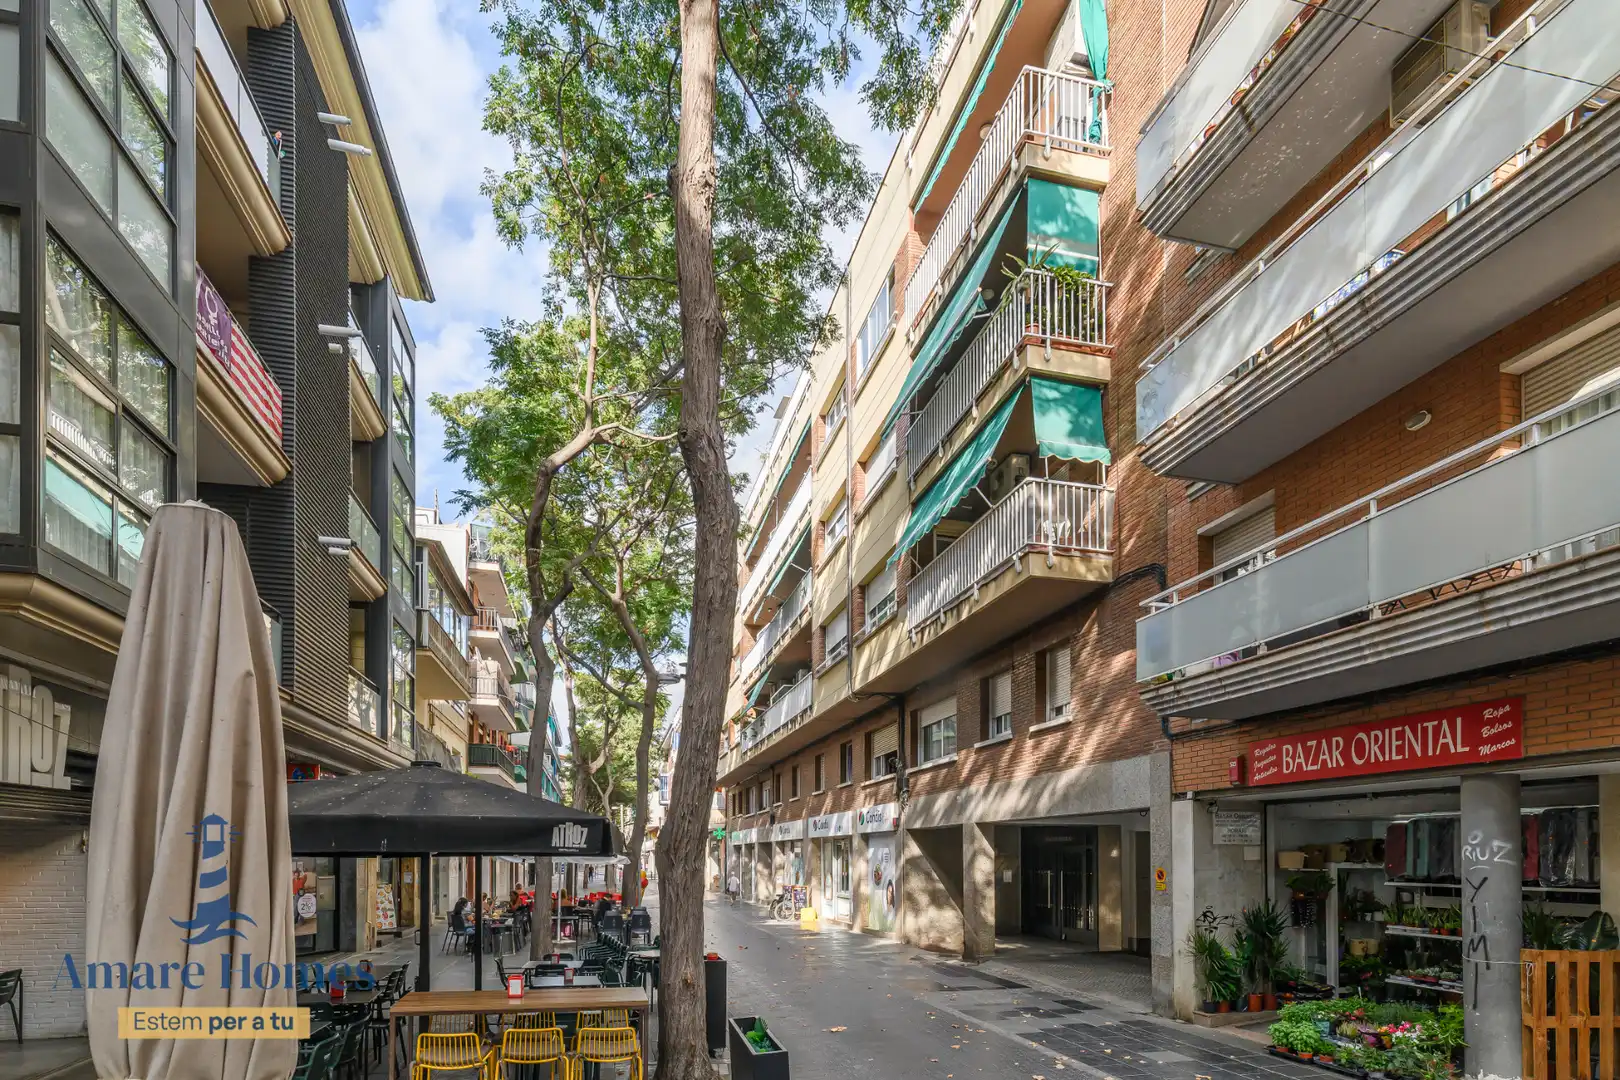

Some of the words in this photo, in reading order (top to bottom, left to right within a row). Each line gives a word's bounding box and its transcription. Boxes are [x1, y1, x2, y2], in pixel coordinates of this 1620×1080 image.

[1483, 704, 1511, 720] Ropa
[1481, 720, 1513, 738] Bolsos
[1254, 743, 1277, 758] Regalos
[1282, 736, 1345, 775] BAZAR
[1351, 716, 1471, 766] ORIENTAL
[1479, 737, 1517, 757] Marcos
[551, 821, 588, 849] ATROZ
